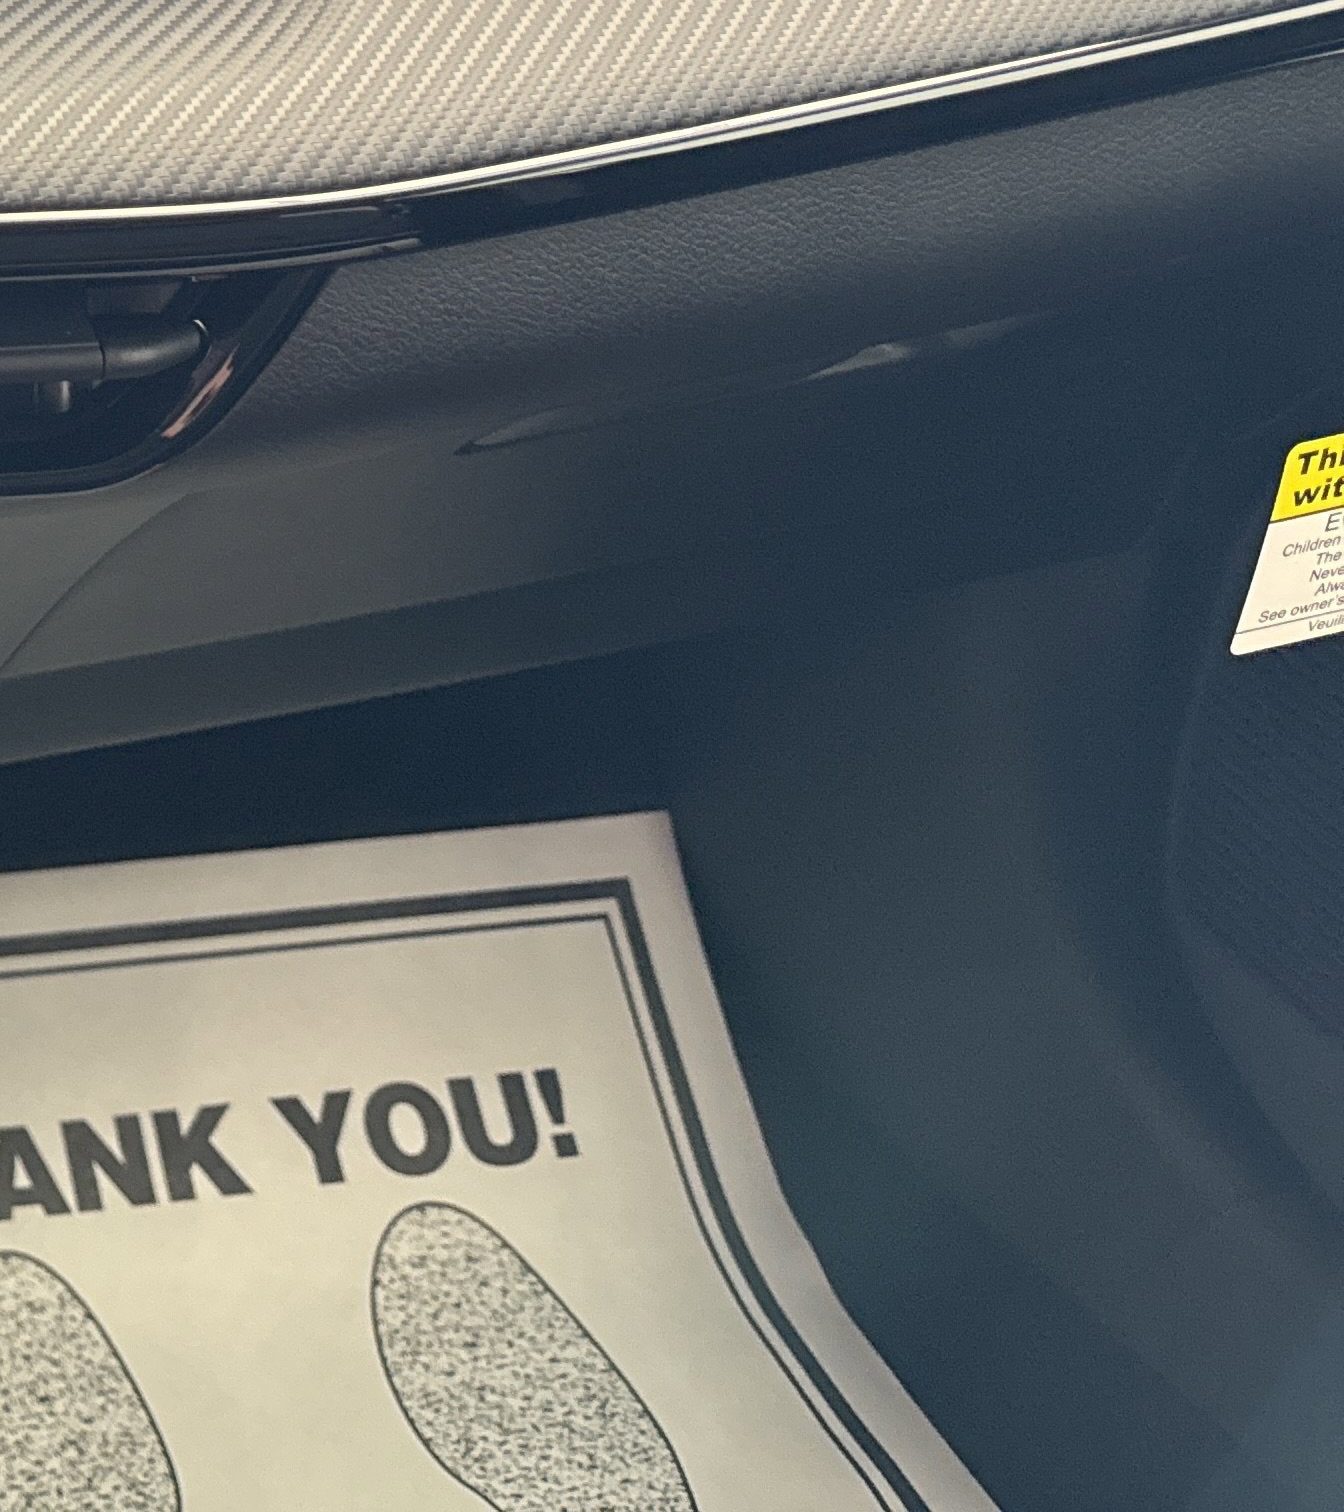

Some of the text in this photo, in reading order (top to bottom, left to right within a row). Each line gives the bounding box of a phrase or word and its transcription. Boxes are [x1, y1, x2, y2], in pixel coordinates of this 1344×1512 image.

[1282, 536, 1342, 558] Children
[1316, 551, 1343, 566] The
[1258, 609, 1287, 624] See
[270, 1067, 582, 1186] YOU!
